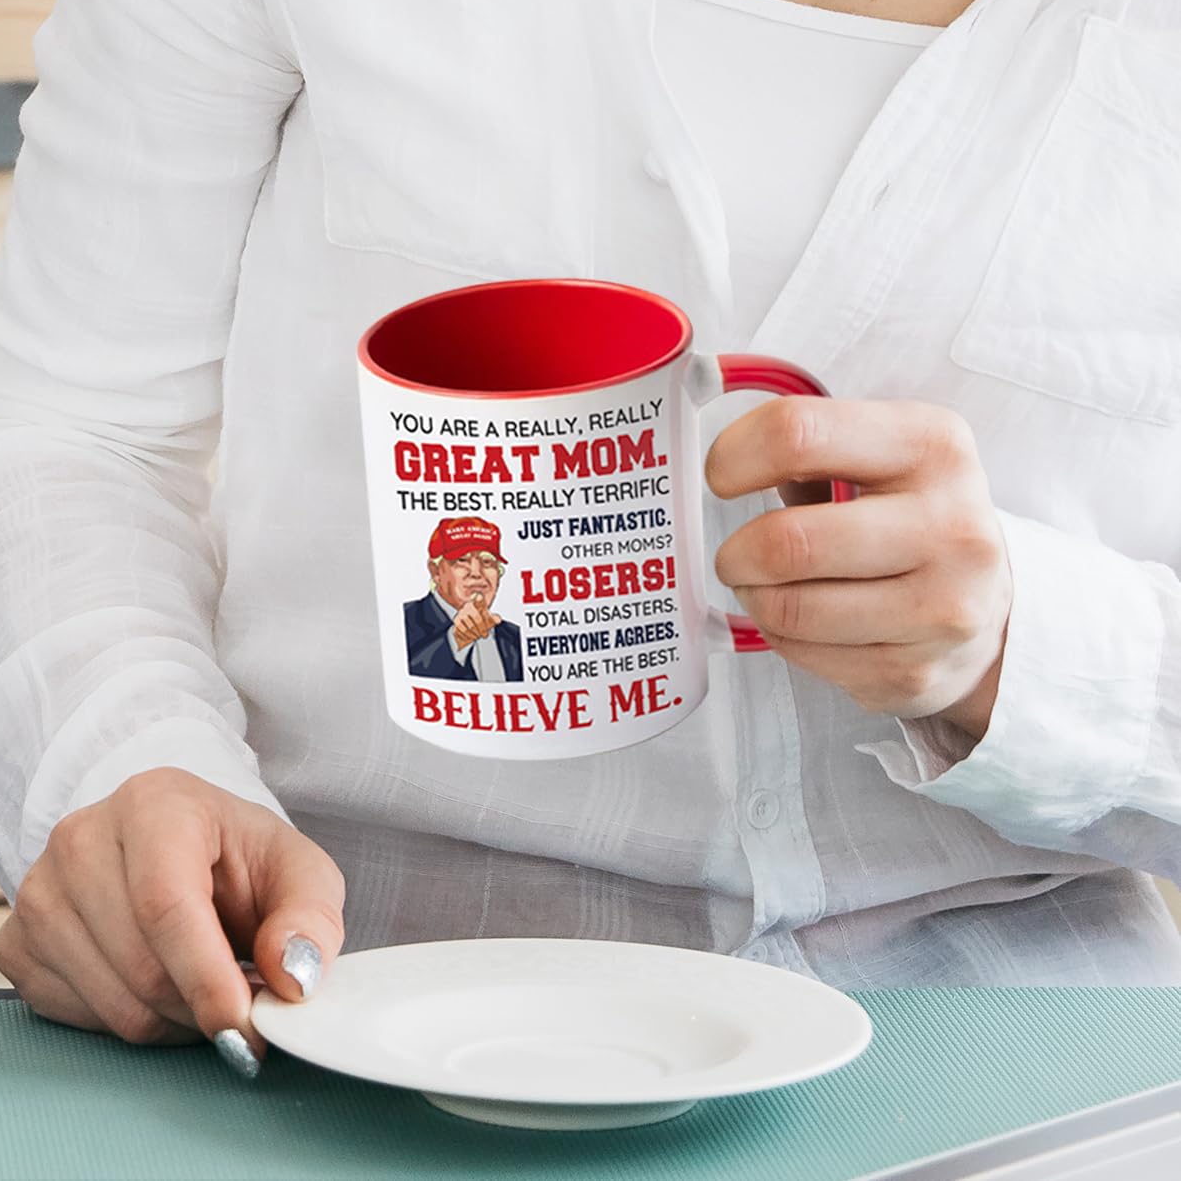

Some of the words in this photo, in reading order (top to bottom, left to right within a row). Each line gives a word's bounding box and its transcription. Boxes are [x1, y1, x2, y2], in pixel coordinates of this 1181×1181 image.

[390, 412, 433, 434] YOU
[440, 419, 478, 437] ARE
[485, 421, 499, 437] A
[505, 417, 583, 438] REALLY,
[590, 398, 663, 430] REALLY
[394, 440, 540, 482] GREAT
[552, 429, 667, 480] MOM.
[397, 490, 438, 511] THE
[444, 491, 496, 511] BEST.
[503, 489, 574, 510] REALLY
[580, 476, 670, 505] TERRIFIC
[518, 519, 564, 540] JUST
[569, 508, 671, 537] FANTASTIC.
[561, 541, 613, 559] OTHER
[619, 535, 672, 555] MOMS?
[521, 557, 676, 604] LOSERS!
[525, 610, 579, 628] TOTAL
[585, 598, 677, 623] DISASTERS.
[527, 632, 611, 657] EVERYONE
[615, 622, 679, 650] AGREES.
[528, 665, 563, 682] YOU
[568, 660, 598, 678] ARE
[603, 656, 635, 674] THE
[639, 647, 679, 670] BEST.
[412, 686, 594, 732] BELIEVE
[608, 675, 683, 723] ME.
